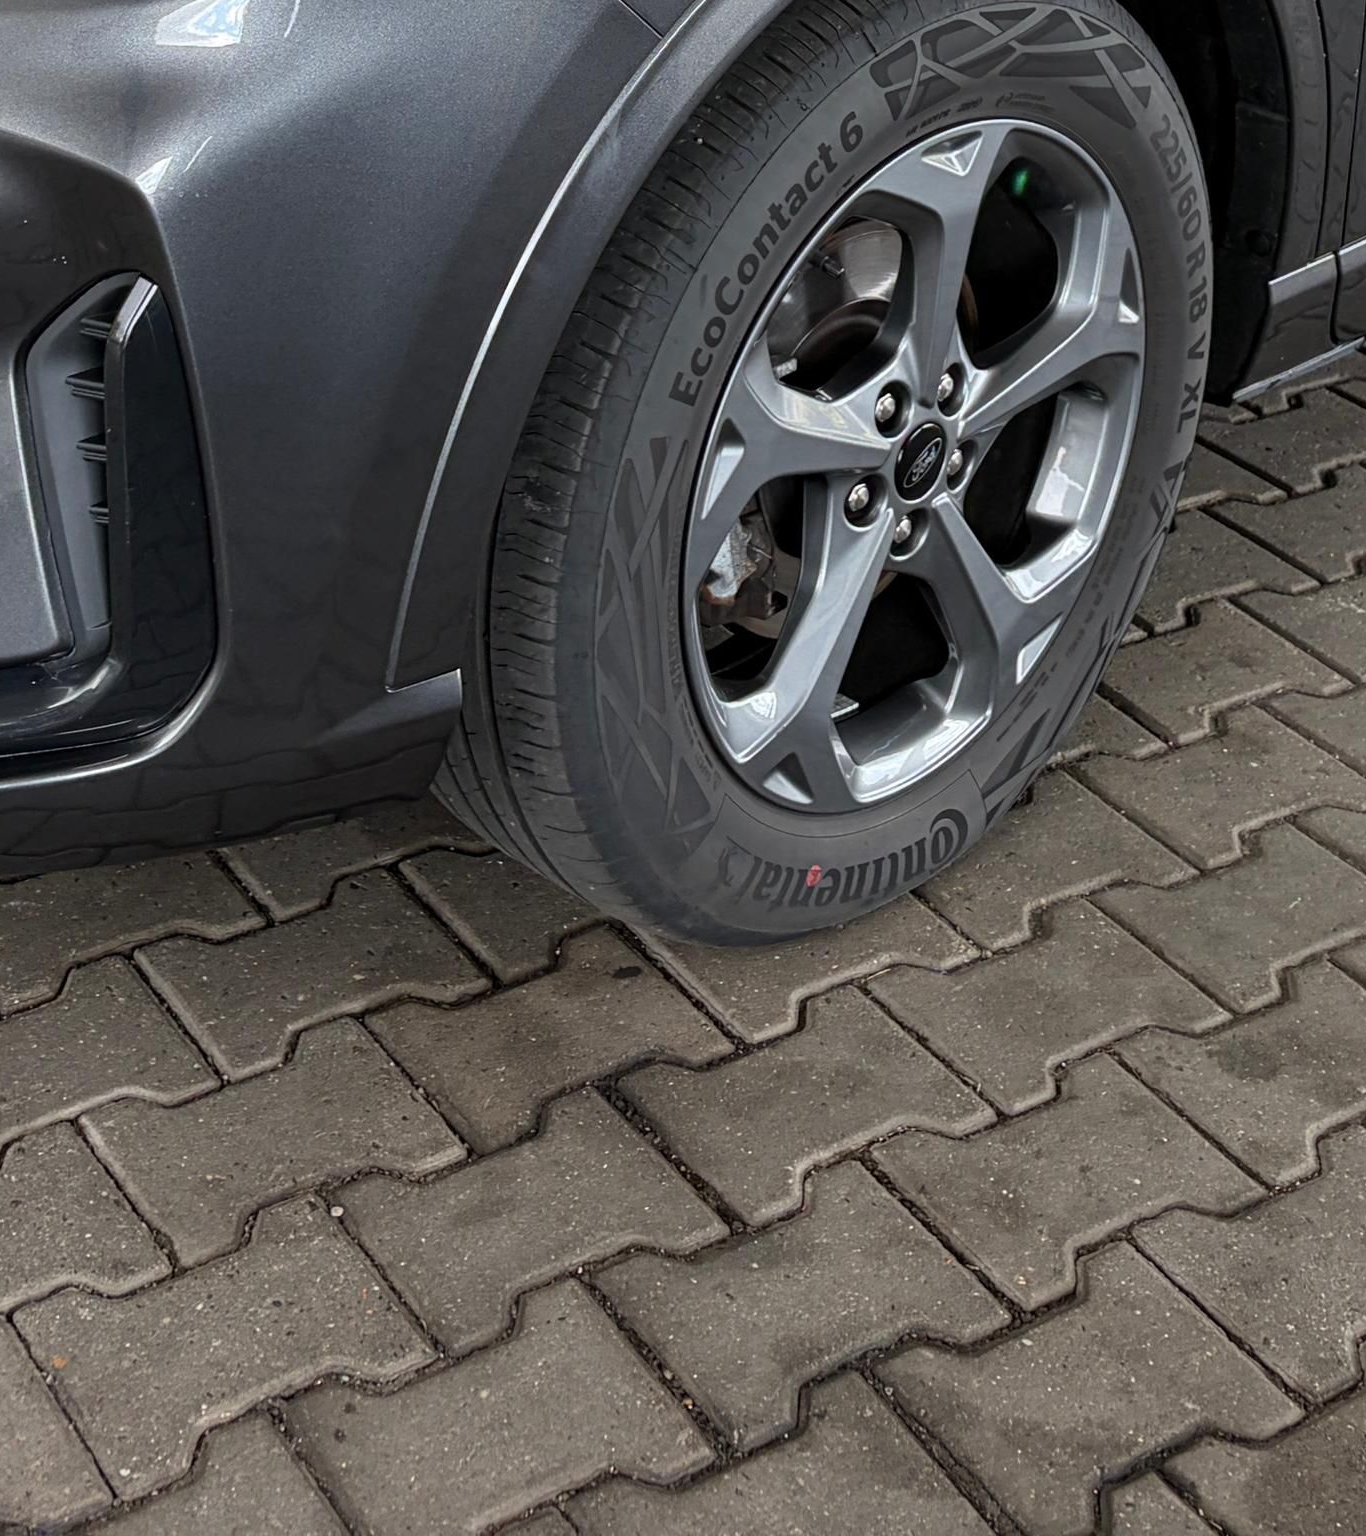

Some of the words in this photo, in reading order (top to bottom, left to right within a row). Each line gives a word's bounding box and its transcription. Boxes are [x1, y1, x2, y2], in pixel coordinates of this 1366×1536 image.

[1149, 113, 1203, 241] 225/60
[668, 142, 837, 407] EcoContact
[840, 111, 864, 153] 6
[1186, 240, 1206, 279] R
[1188, 275, 1208, 324] 18
[1187, 331, 1206, 360] V
[1177, 376, 1202, 433] XL
[732, 809, 968, 912] Continental
